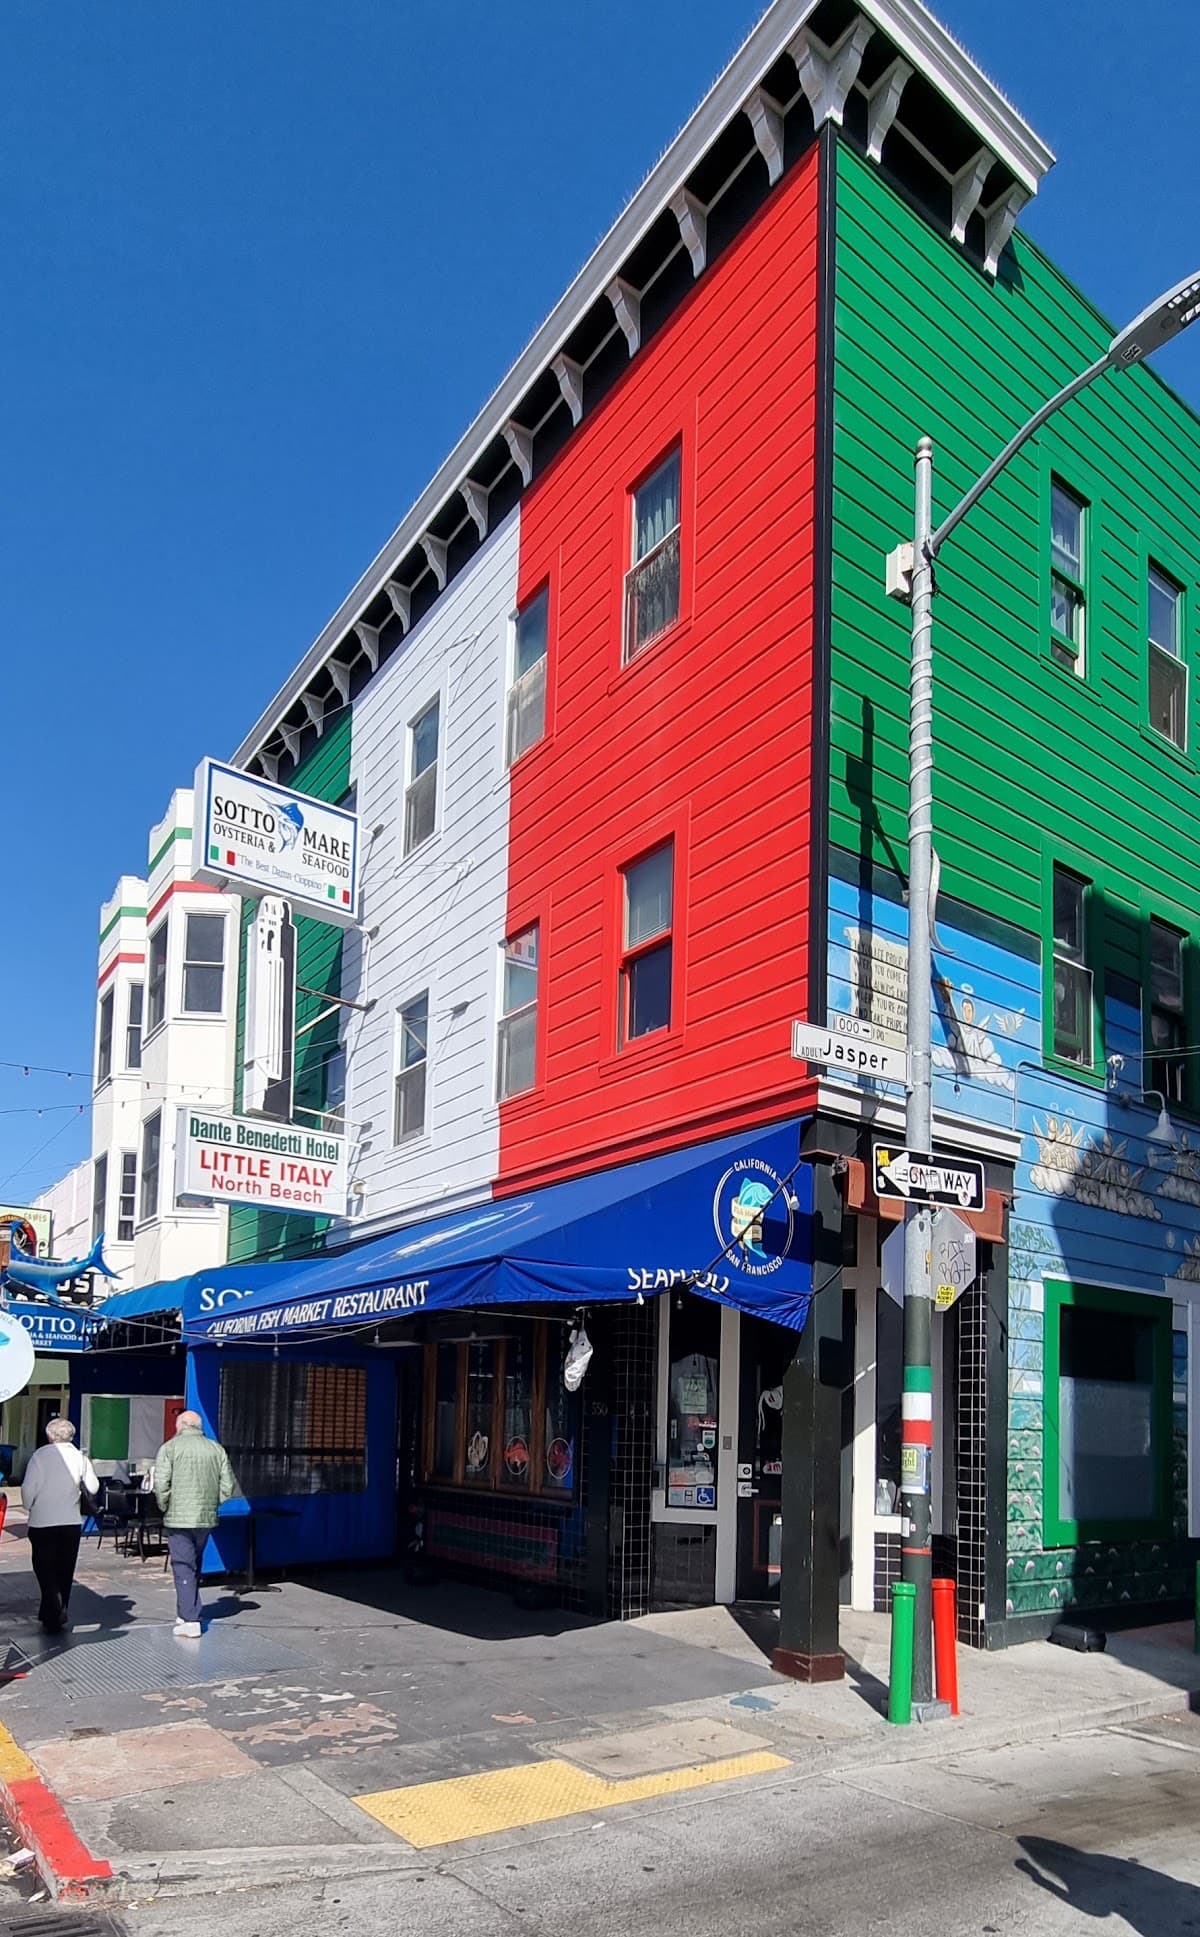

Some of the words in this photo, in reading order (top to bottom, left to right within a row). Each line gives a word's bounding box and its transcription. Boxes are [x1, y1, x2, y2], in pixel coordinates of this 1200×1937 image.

[213, 796, 276, 834] SOTTO
[303, 827, 351, 862] MARE
[213, 822, 265, 851] OYSTERIA
[267, 841, 276, 854] &
[301, 852, 350, 879] SEAFOOD
[823, 1038, 888, 1071] Jasper
[190, 1117, 231, 1142] Dante
[236, 1124, 301, 1154] Benedetti
[306, 1137, 339, 1161] Hotel
[200, 1150, 271, 1178] LITTLE
[280, 1162, 333, 1188] ITALY
[734, 1158, 777, 1180] CALIFORNIA
[943, 1171, 972, 1191] WAY
[211, 1174, 262, 1195] North
[270, 1183, 322, 1204] Beach
[725, 1249, 741, 1268] SAN
[741, 1256, 783, 1277] FRANCISCO
[11, 1313, 76, 1333] OTTO
[206, 1314, 258, 1338] CALIFORNIA
[257, 1307, 282, 1331] FISH
[281, 1299, 332, 1327] MARKET
[332, 1280, 430, 1319] RESTAURANT
